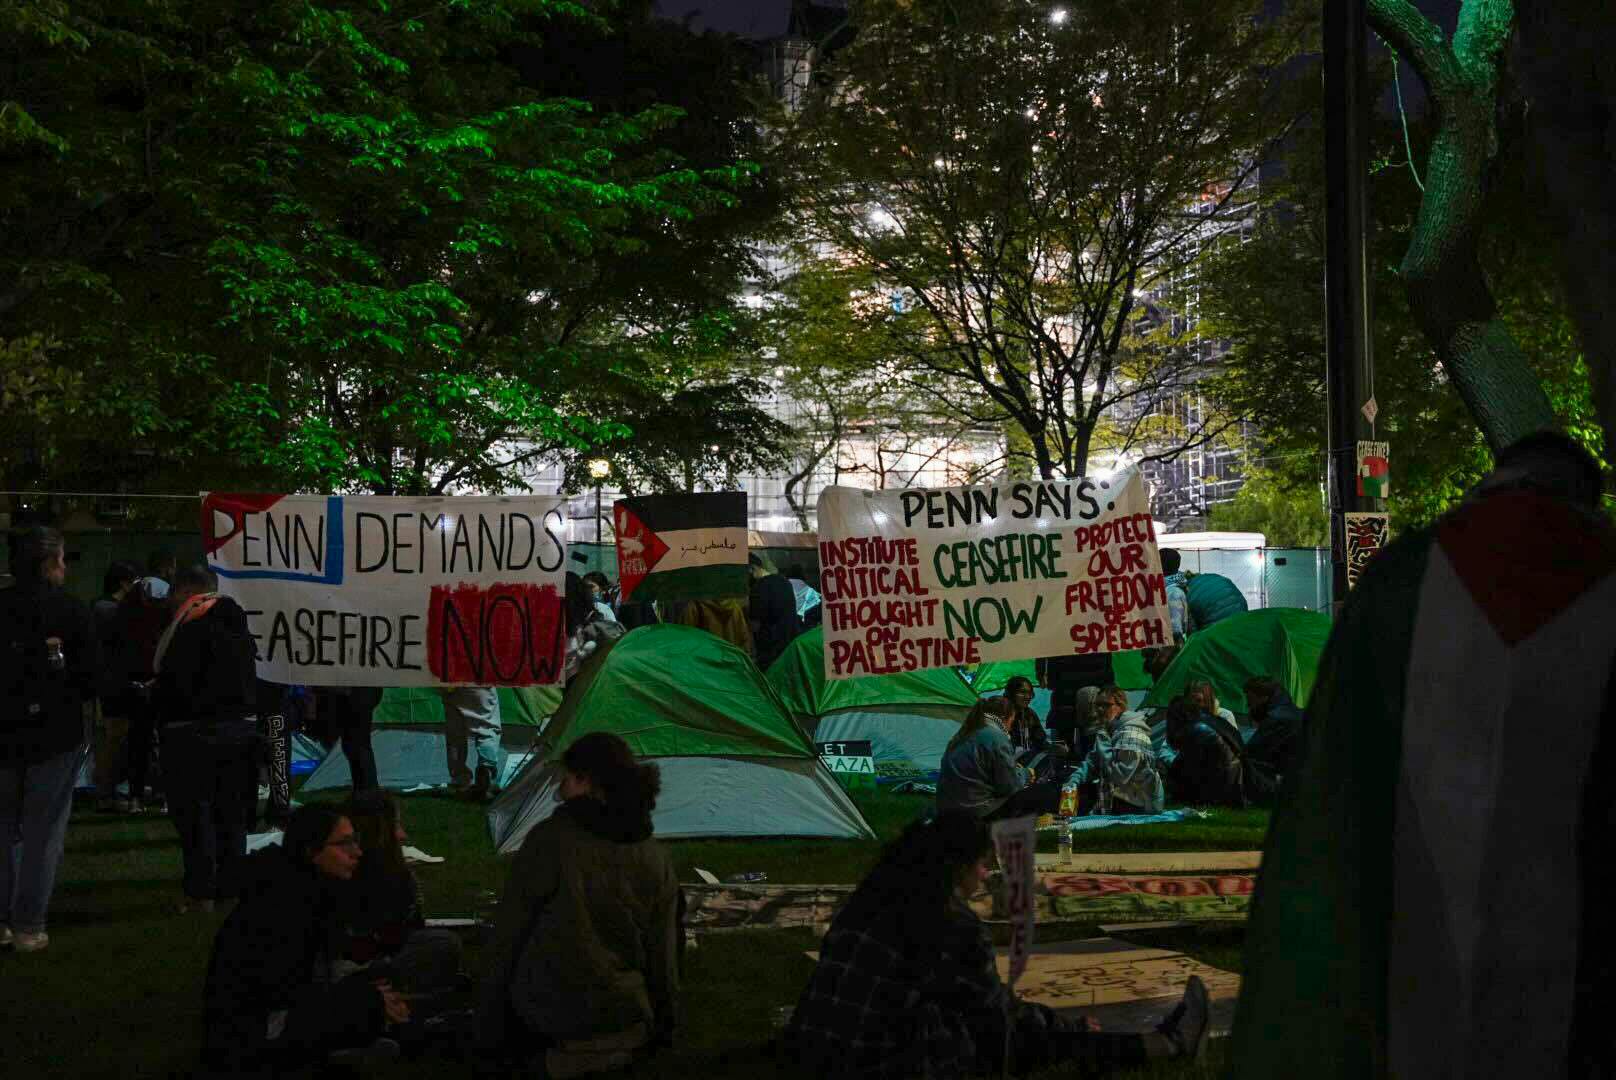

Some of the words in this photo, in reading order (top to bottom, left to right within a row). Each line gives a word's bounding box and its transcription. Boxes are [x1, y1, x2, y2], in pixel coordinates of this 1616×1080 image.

[901, 486, 998, 528] PENN
[1011, 481, 1115, 520] SAYS:
[209, 509, 324, 573] PENN
[356, 509, 564, 573] DEMANDS
[820, 536, 920, 567] INSTITUTE
[1074, 513, 1156, 553] PROTECT
[933, 533, 1068, 588] CEASEFIRE
[1087, 544, 1147, 578] OUR
[821, 566, 928, 601] CRITICAL
[1065, 573, 1167, 616] FREEDOM
[826, 598, 938, 632] THOUGHT
[942, 595, 1043, 643] NOW
[246, 607, 422, 670] EASEFIRE
[444, 594, 566, 682] NOW
[829, 636, 982, 676] PALESTINE
[866, 625, 900, 648] ON
[1070, 618, 1165, 654] SPEECH
[820, 743, 846, 755] ET
